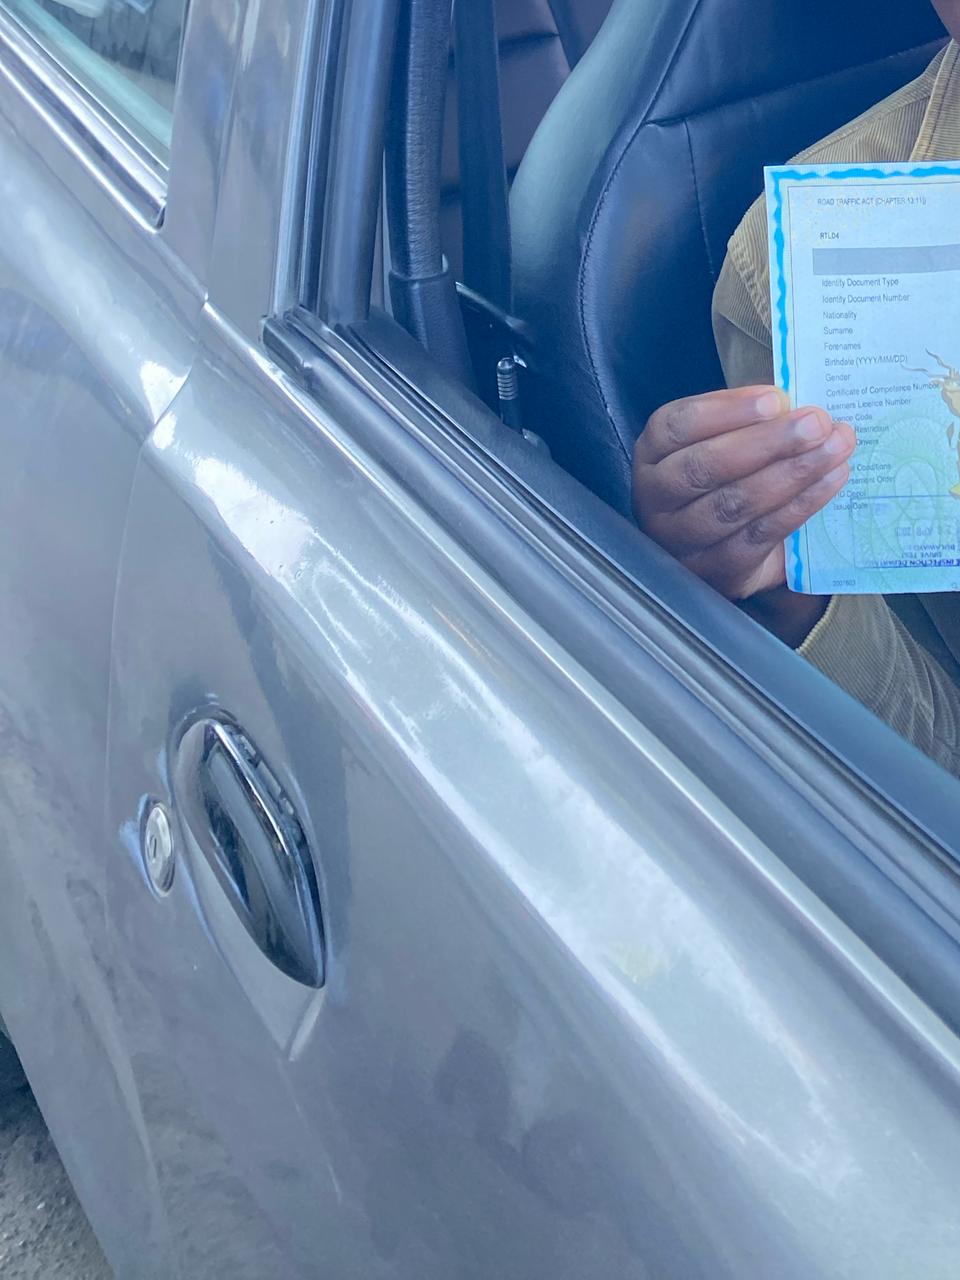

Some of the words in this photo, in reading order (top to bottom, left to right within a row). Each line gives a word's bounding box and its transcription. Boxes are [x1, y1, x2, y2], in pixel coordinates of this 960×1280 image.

[821, 278, 845, 288] Identity
[847, 278, 881, 287] Document
[881, 277, 899, 288] Type
[822, 295, 846, 304] Identity
[847, 294, 881, 303] Document
[882, 293, 910, 302] Number
[822, 311, 857, 320] Nationality
[823, 326, 853, 335] Surname
[824, 342, 861, 351] Forenames
[825, 373, 851, 382] Gender
[885, 399, 911, 407] Number
